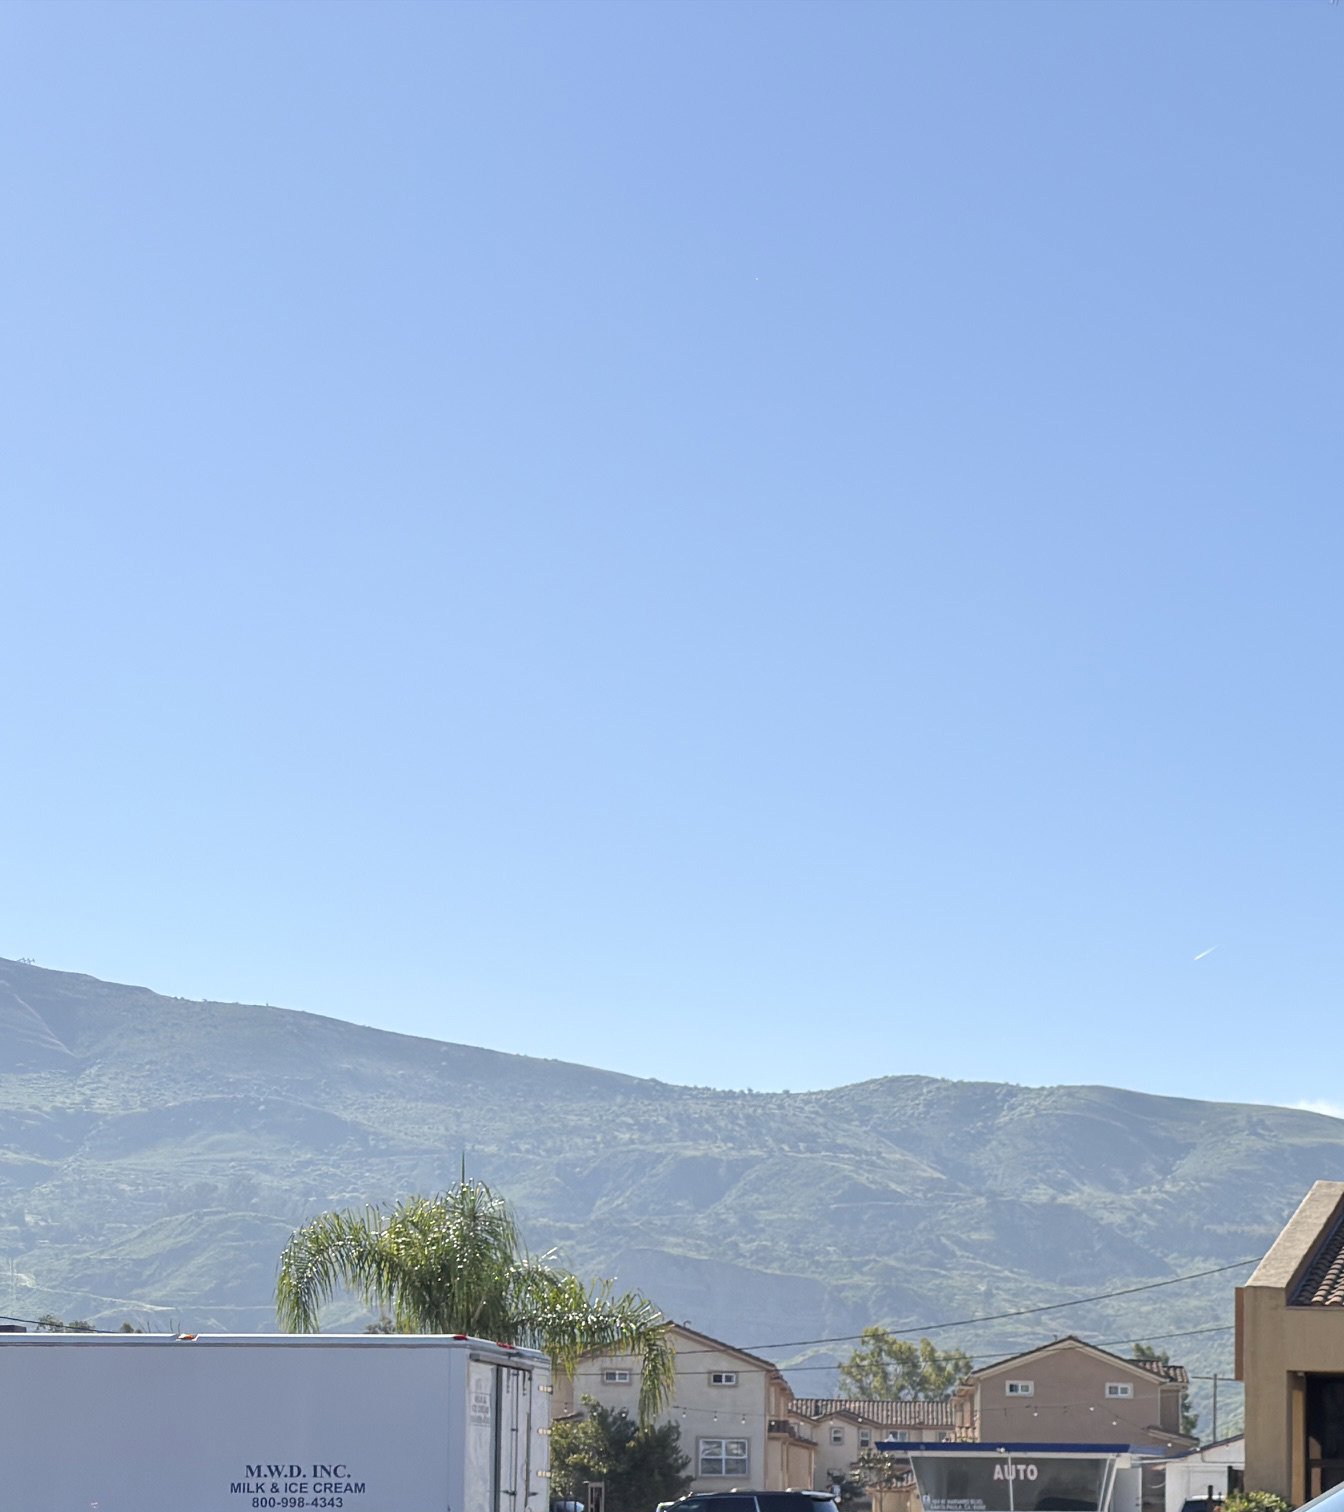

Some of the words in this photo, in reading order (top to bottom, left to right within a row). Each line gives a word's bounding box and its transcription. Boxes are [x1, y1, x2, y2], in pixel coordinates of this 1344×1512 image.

[245, 1464, 307, 1479] M.W.D.
[312, 1464, 351, 1479] INC.
[993, 1464, 1038, 1481] AUTO
[230, 1482, 265, 1494] MILK
[270, 1482, 280, 1494] &
[284, 1482, 308, 1494] ICE
[313, 1482, 366, 1494] CREAM
[252, 1496, 344, 1508] 800-998-4343
